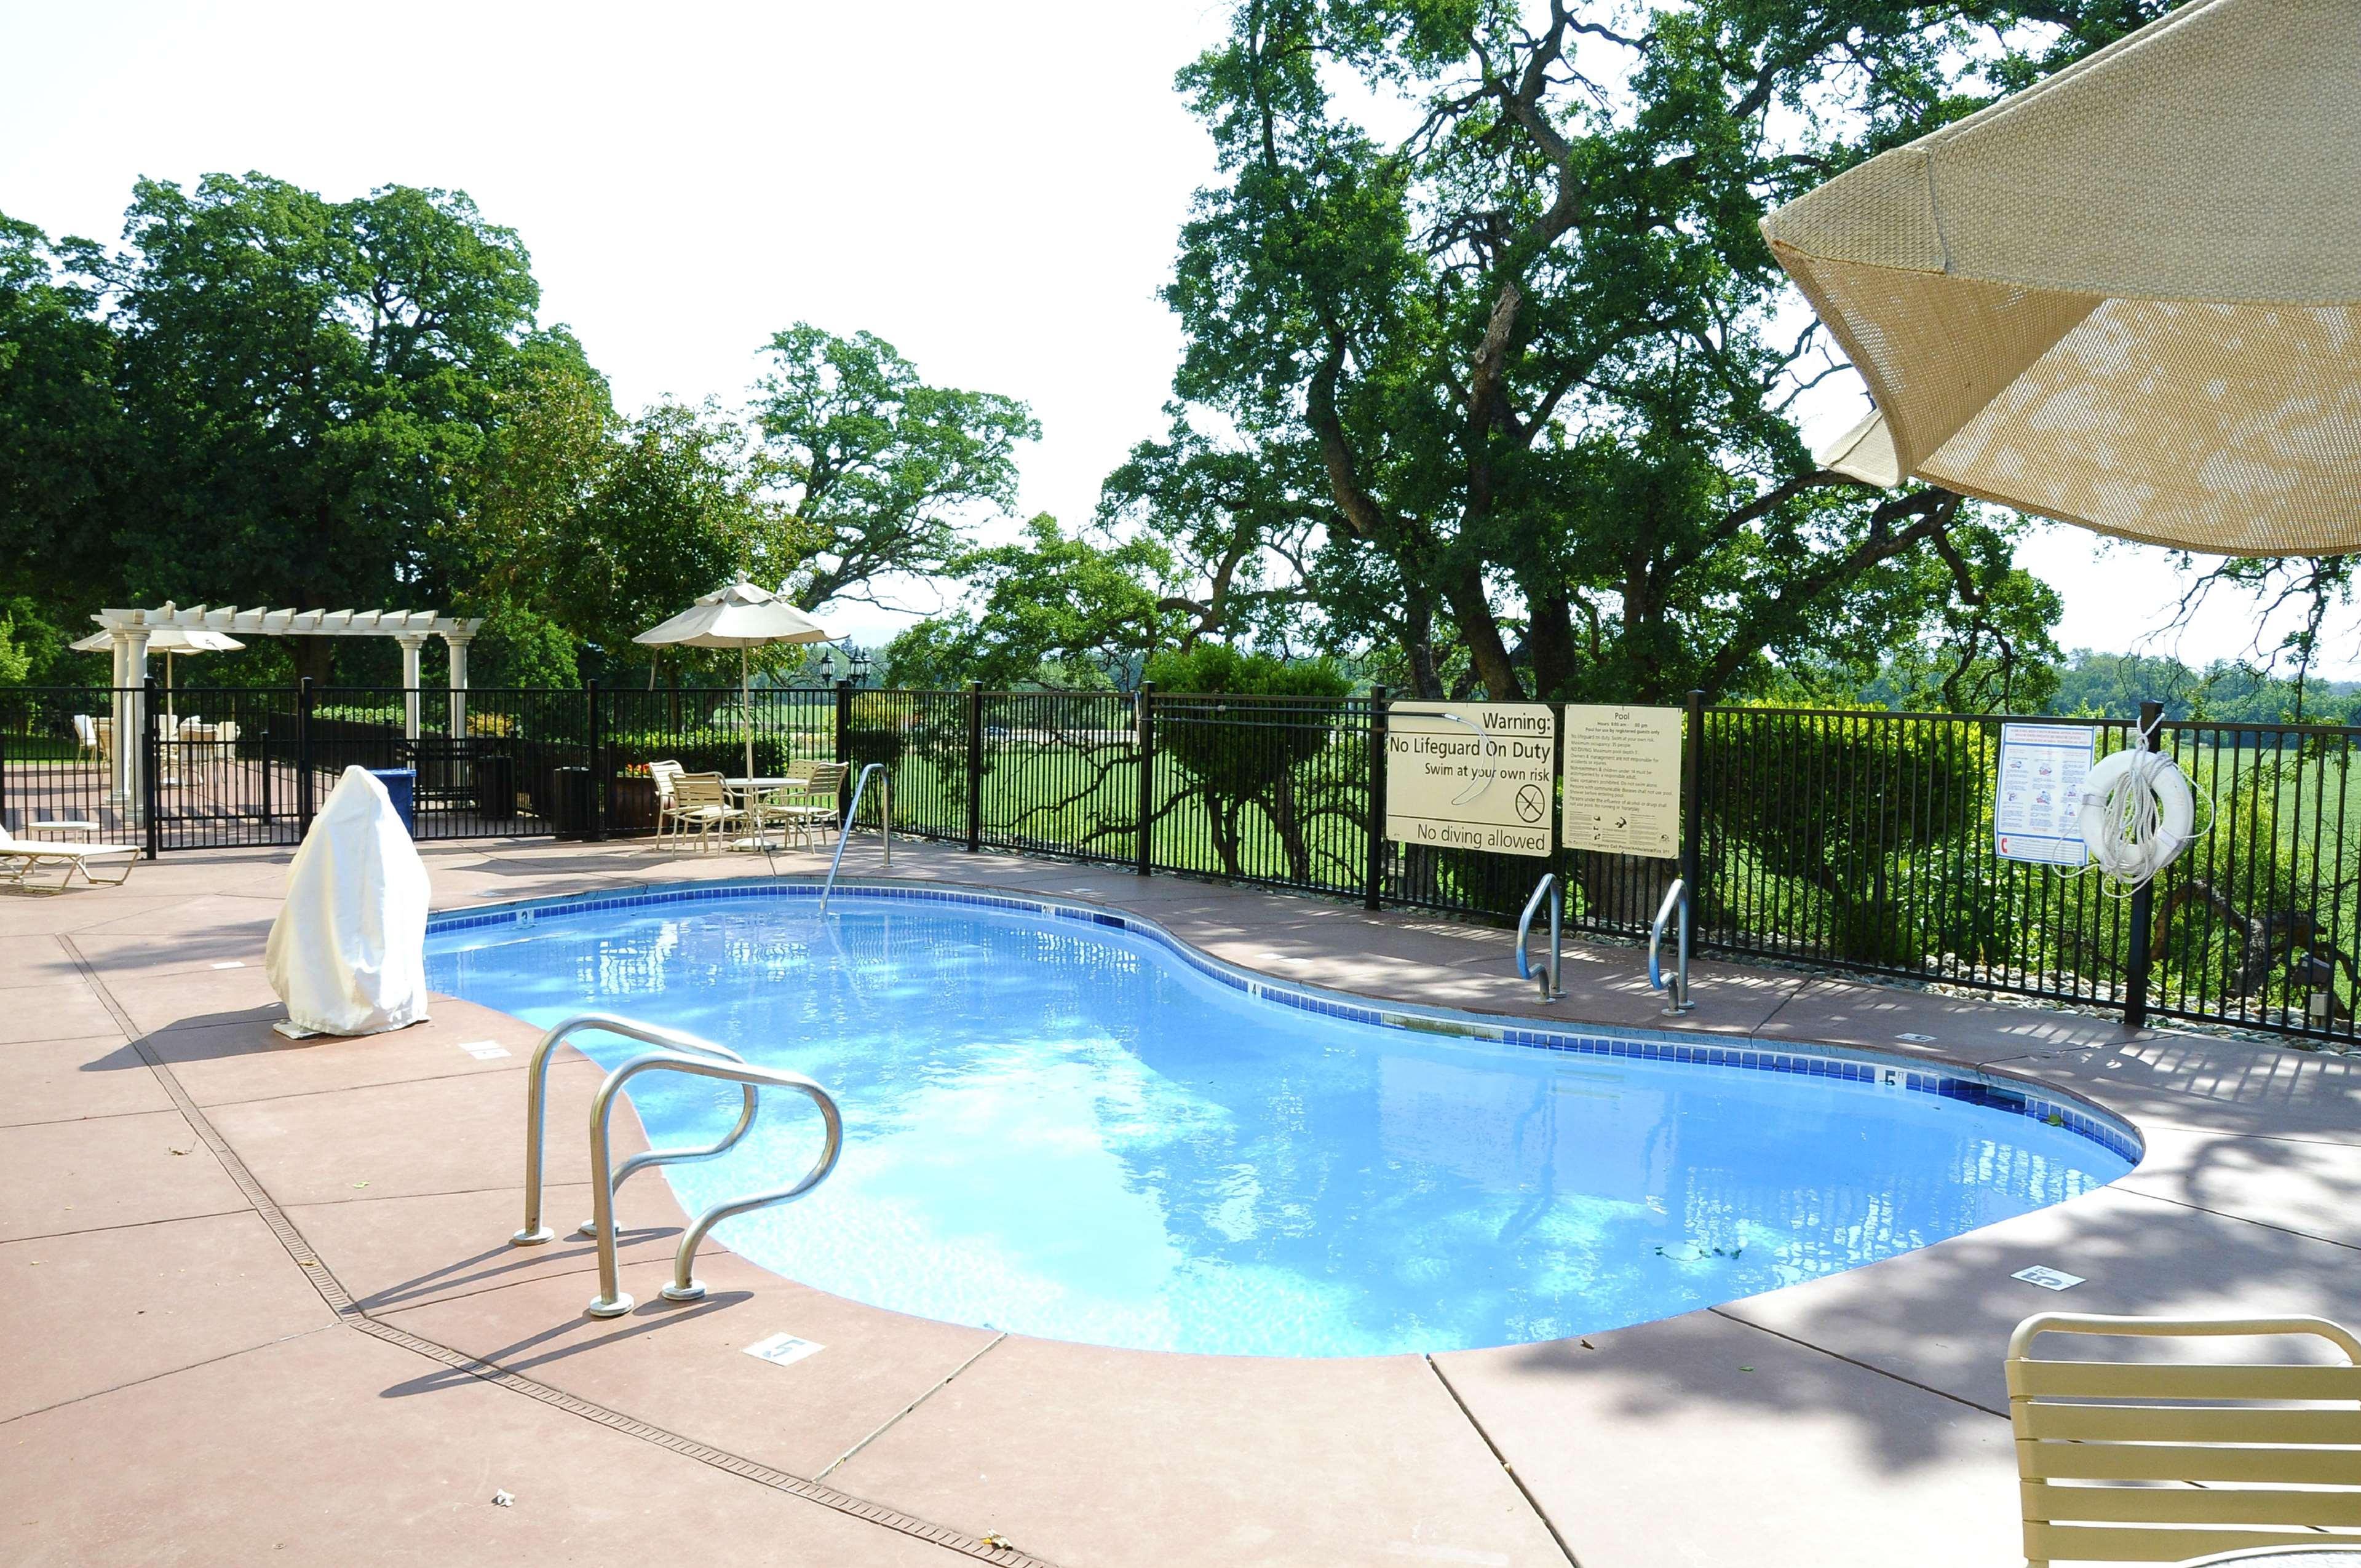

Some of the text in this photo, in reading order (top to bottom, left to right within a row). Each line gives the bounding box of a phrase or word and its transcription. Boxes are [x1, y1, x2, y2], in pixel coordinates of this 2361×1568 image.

[1483, 712, 1551, 734] Warning:
[1390, 737, 1550, 763] No Lifeguard On Duty
[1425, 763, 1550, 782] Swim at your own risk
[1418, 823, 1544, 850] No diving allowed
[1884, 1070, 1895, 1085] 5
